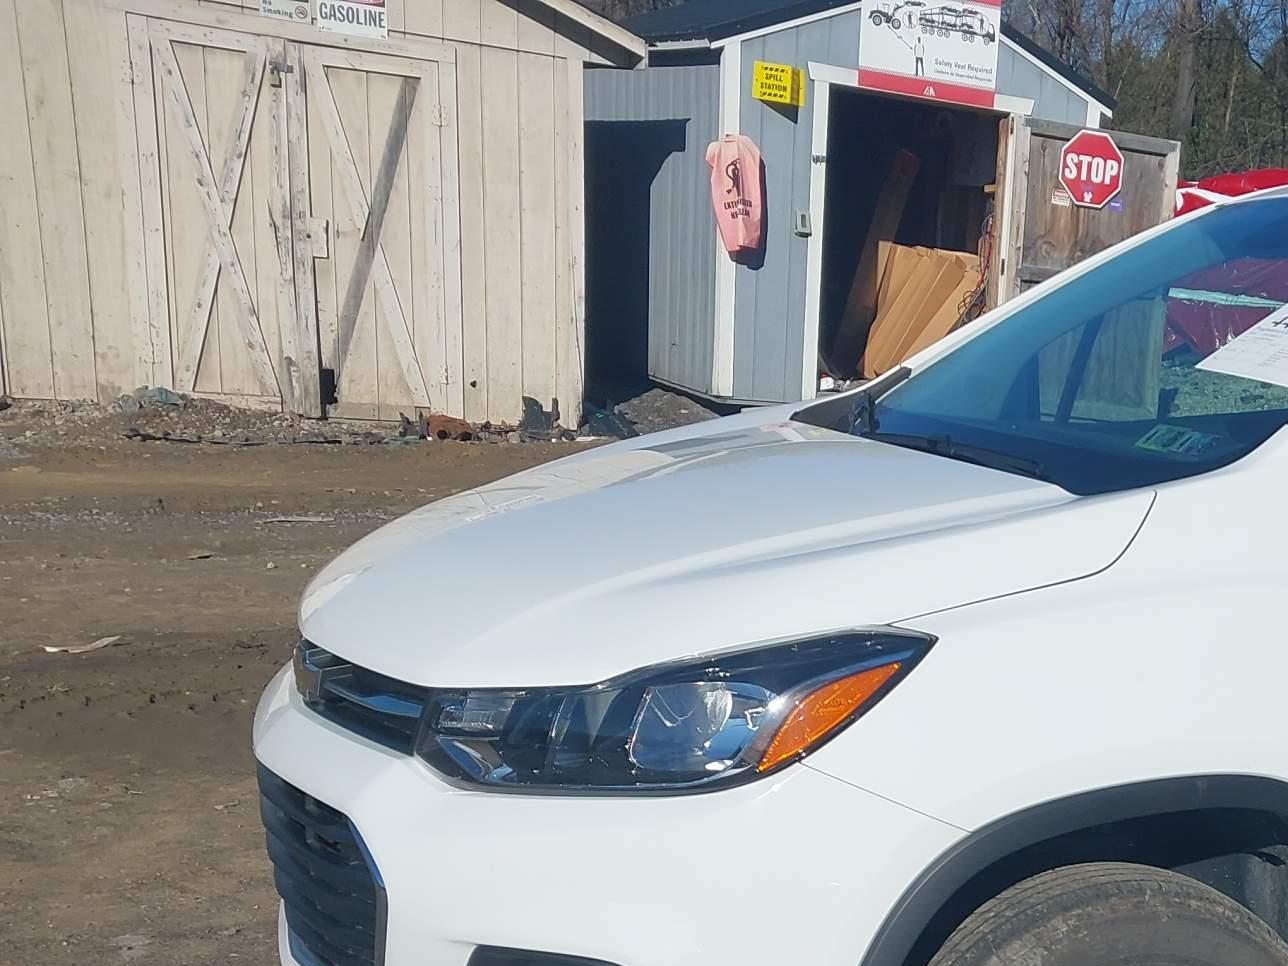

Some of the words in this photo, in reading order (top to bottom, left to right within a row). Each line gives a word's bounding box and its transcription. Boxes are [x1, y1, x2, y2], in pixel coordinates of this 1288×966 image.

[262, 6, 293, 19] Smoking
[319, 2, 386, 28] GASOLINE
[934, 58, 952, 68] Safety
[954, 62, 966, 70] Vest
[968, 64, 992, 74] Required
[765, 73, 783, 82] SPILL
[760, 82, 787, 92] STATION
[1064, 152, 1119, 185] STOP
